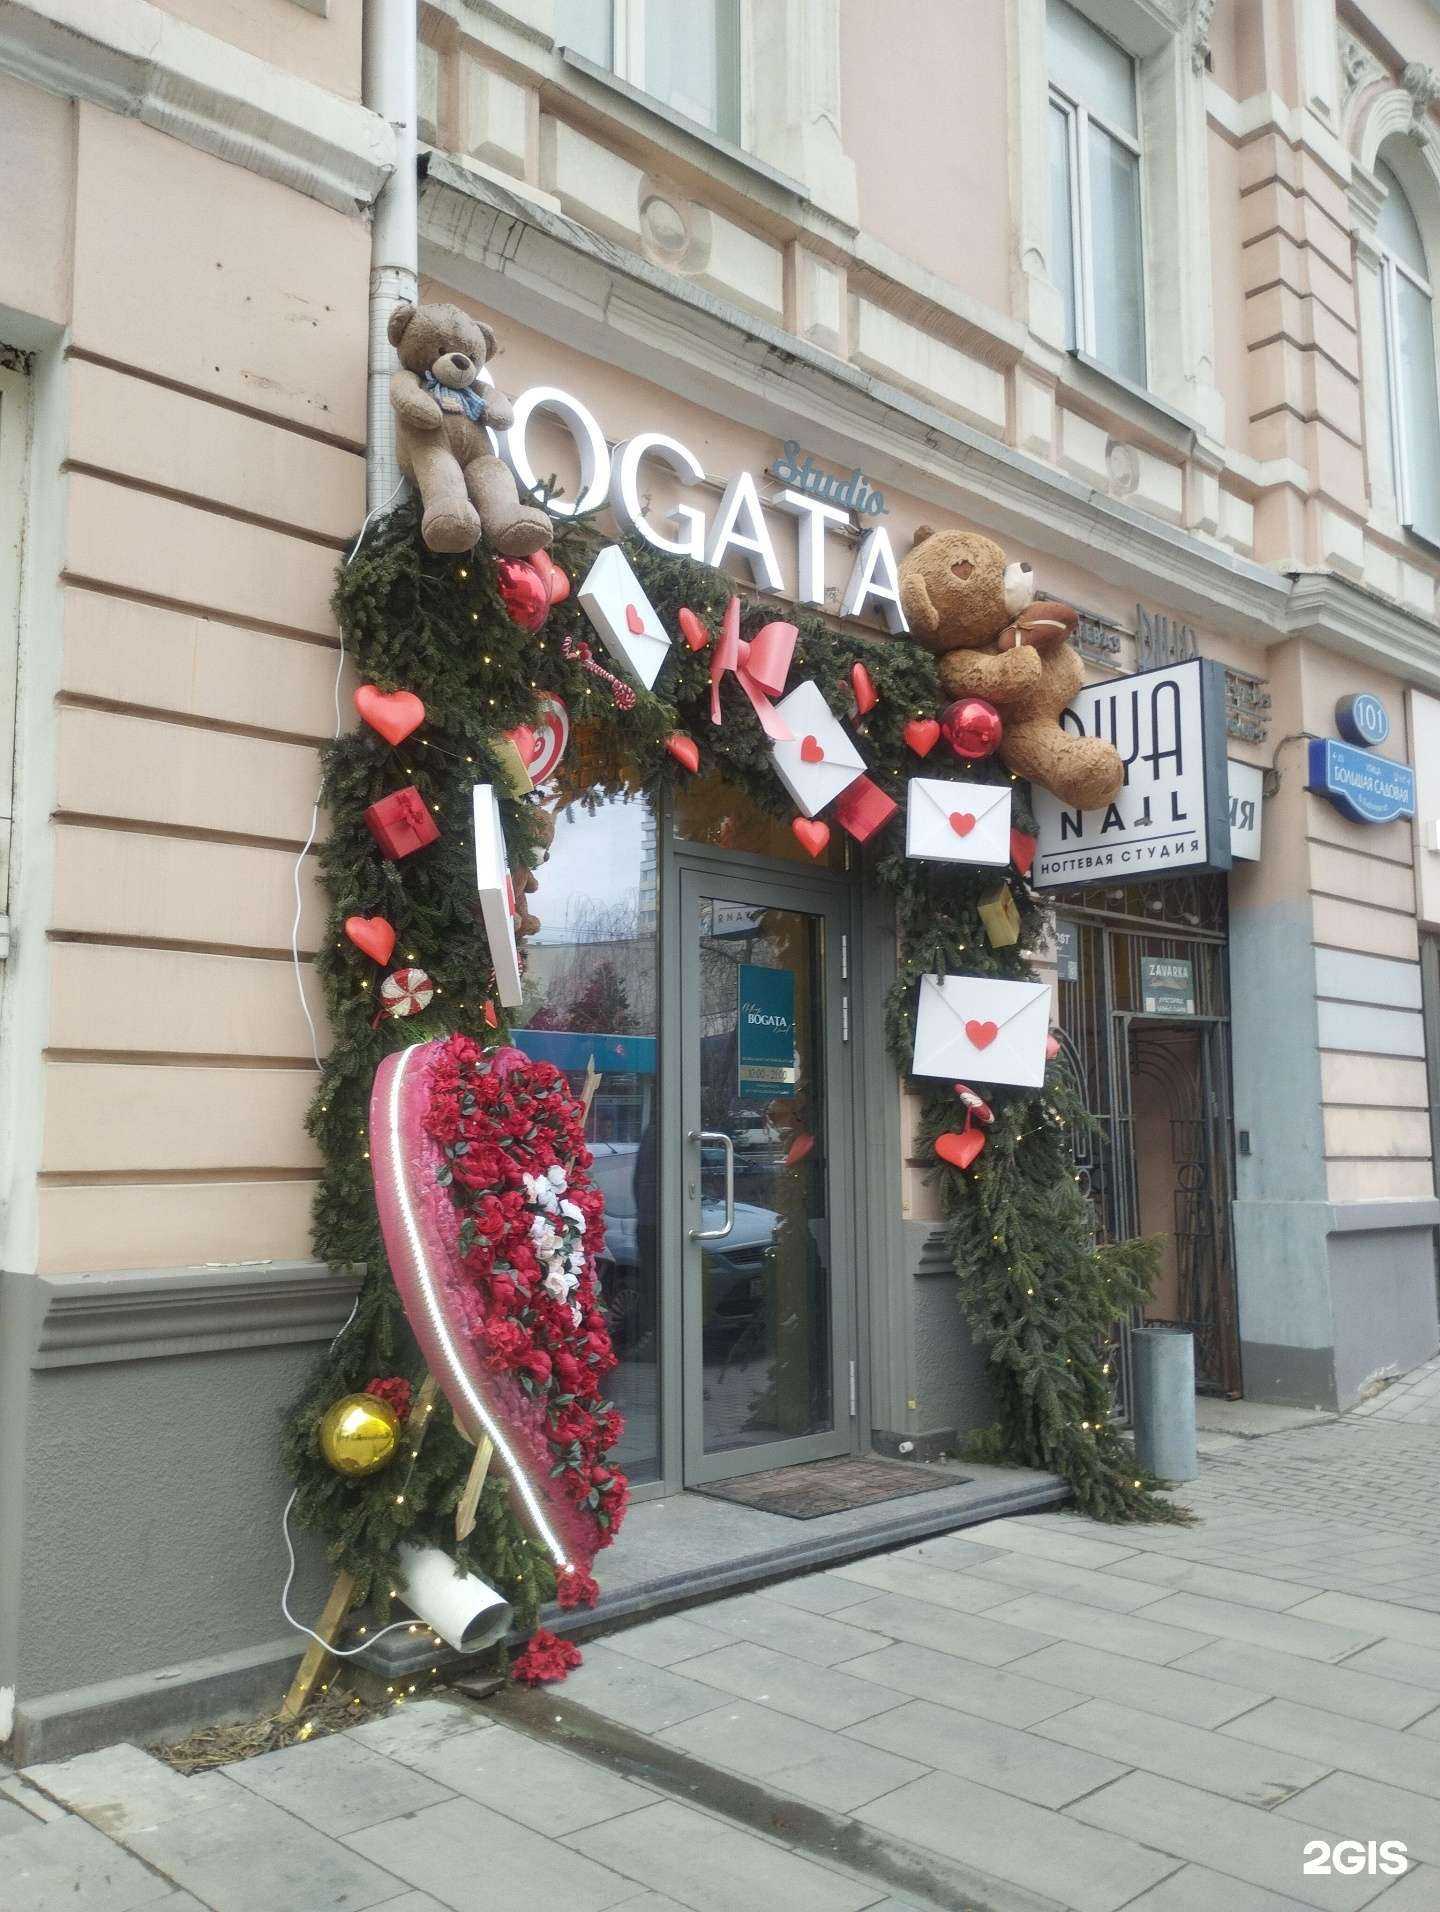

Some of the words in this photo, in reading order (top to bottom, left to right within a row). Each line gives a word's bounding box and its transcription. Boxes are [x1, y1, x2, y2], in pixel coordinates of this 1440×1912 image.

[771, 440, 890, 515] Studio
[478, 368, 910, 635] OGATA
[1358, 702, 1384, 733] 101
[1334, 766, 1374, 791] БОЛЬШАЯ
[1374, 780, 1409, 803] САДОВАЯ
[1061, 791, 1188, 841] NAIL
[1041, 853, 1114, 875] НОГТЕВАЯ
[1121, 840, 1200, 863] СТУДИЯ
[1149, 964, 1189, 979] ZAVARKA
[747, 1013, 787, 1027] BOGATA
